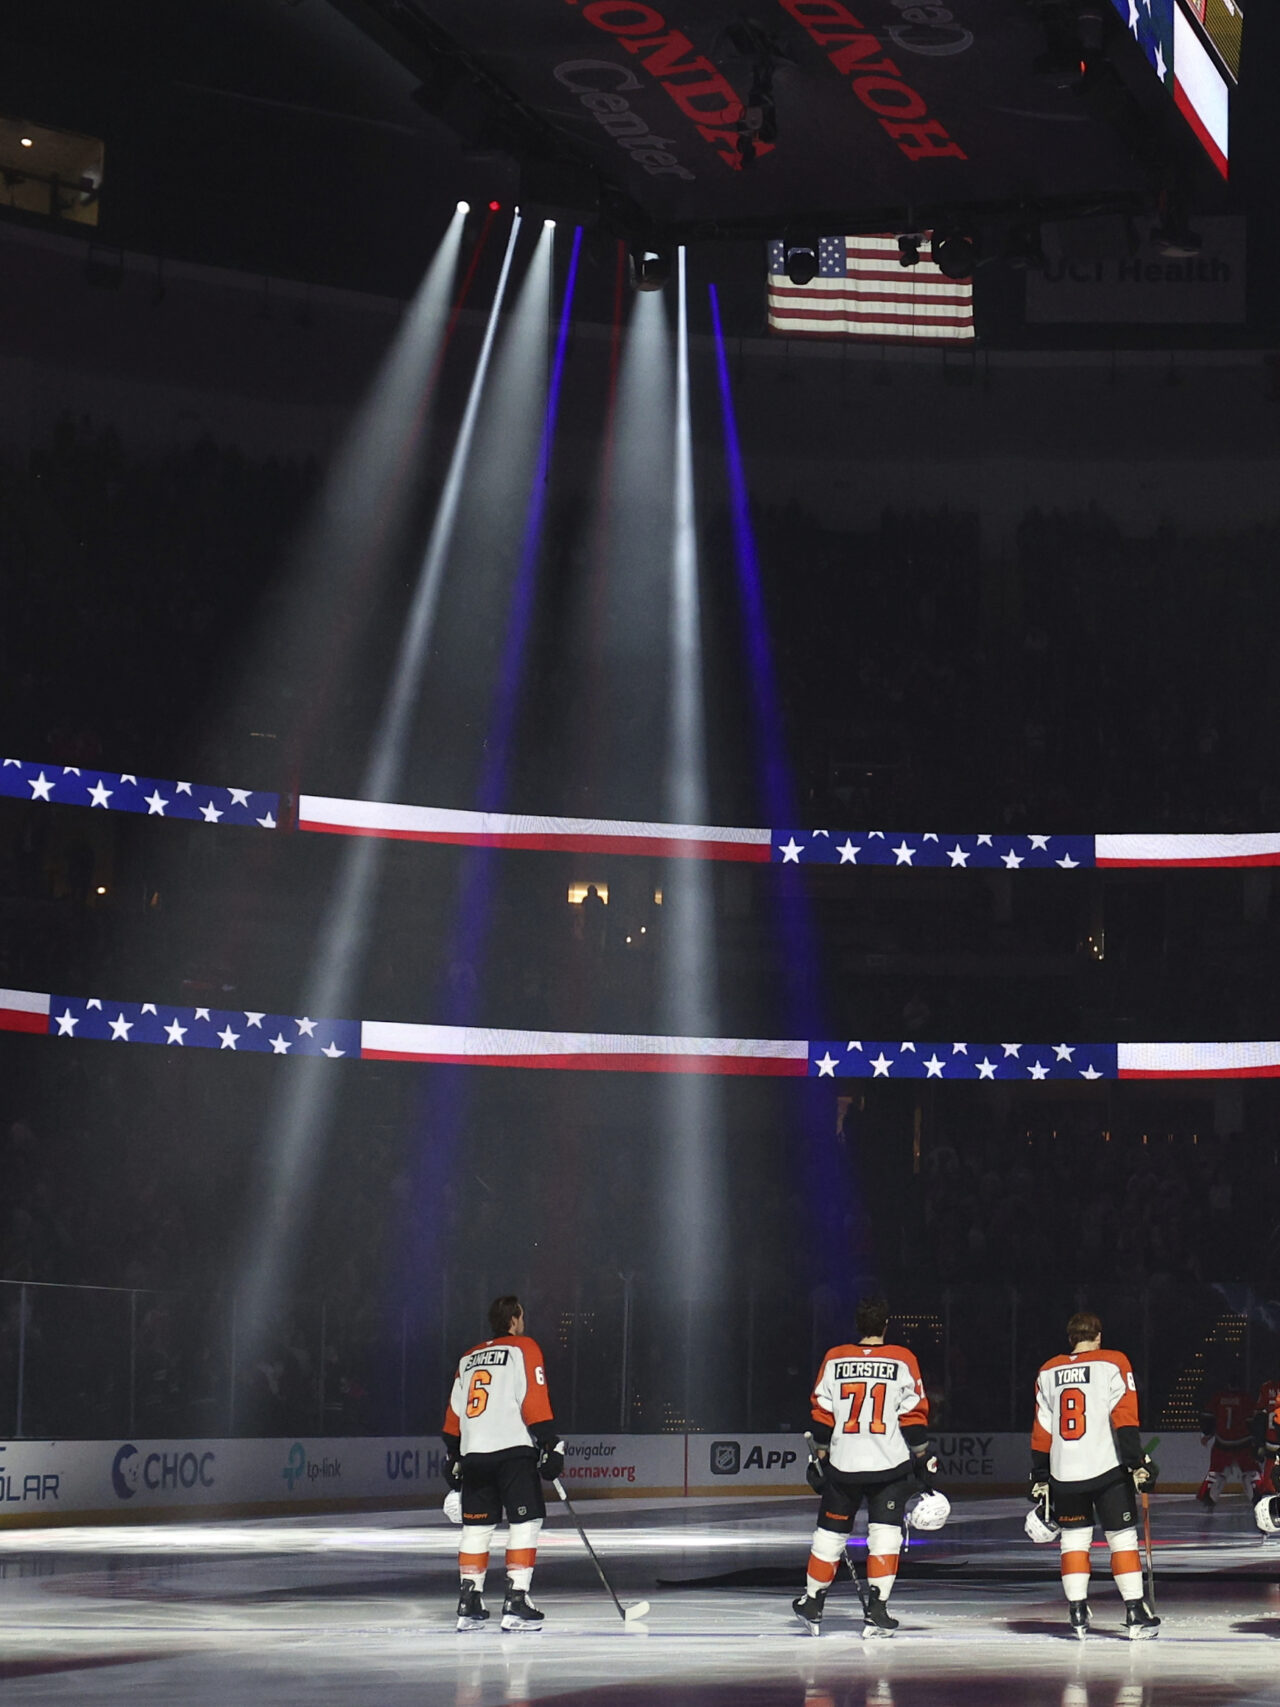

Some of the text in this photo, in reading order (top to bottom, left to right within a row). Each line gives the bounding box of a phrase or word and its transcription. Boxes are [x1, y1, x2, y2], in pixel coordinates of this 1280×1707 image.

[564, 0, 776, 171] ONDA
[778, 0, 968, 162] HOND
[553, 59, 697, 183] Center
[1117, 257, 1230, 283] Health
[535, 1366, 546, 1386] 6
[836, 1362, 896, 1379] FOERSTER
[1057, 1367, 1088, 1385] YORK
[466, 1369, 493, 1419] 6
[840, 1382, 888, 1435] 71
[1060, 1387, 1087, 1441] 8
[144, 1451, 215, 1490] CHOC
[307, 1457, 342, 1481] tp-link
[387, 1450, 420, 1480] UCI
